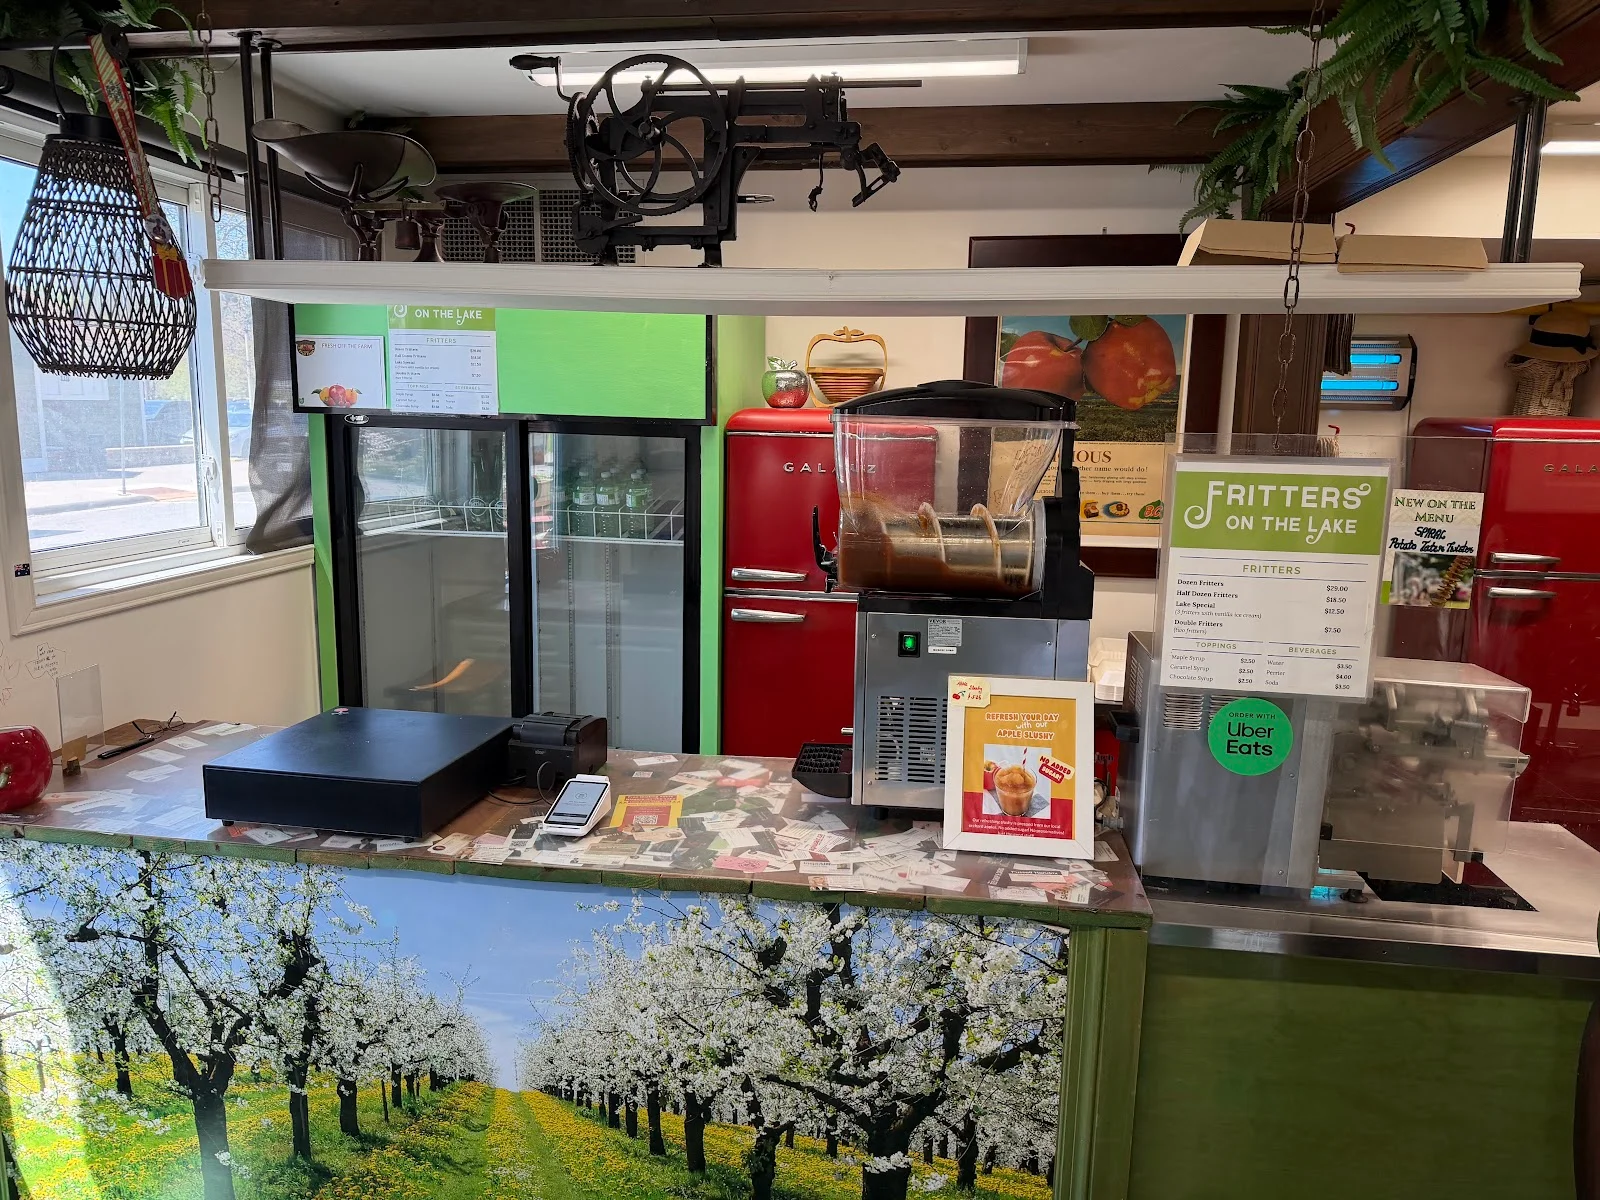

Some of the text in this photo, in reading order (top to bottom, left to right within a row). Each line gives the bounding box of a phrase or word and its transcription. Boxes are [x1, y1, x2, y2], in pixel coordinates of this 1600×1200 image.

[415, 308, 483, 326] ON THE LAKE
[1183, 481, 1372, 530] FRITTERS
[1394, 497, 1476, 510] NEW ON THE
[1414, 512, 1455, 523] MENU
[1226, 515, 1358, 545] ON THE LAKE
[1414, 526, 1447, 540] SPIRAL
[1389, 537, 1418, 550] Potato
[1242, 564, 1301, 575] FRITTERS
[1199, 579, 1224, 587] Fritters
[1326, 584, 1349, 592] $29.00
[1325, 596, 1347, 604] $18.50
[1192, 601, 1216, 609] Special
[1324, 607, 1345, 615] $12.50
[1324, 626, 1342, 634] $7.50
[1195, 641, 1237, 650] TOPPINGS
[1288, 646, 1337, 655] BEVERAGES
[985, 712, 1060, 721] REFRESH YOUR DAY
[1228, 711, 1276, 720] ORDER WITH
[1016, 720, 1032, 729] with
[1227, 721, 1274, 739] Uber
[996, 729, 1055, 740] APPLE SLUSHY
[1226, 739, 1273, 756] Eats
[1039, 755, 1072, 776] NO ADDED
[1041, 766, 1061, 781] SUGAR!
